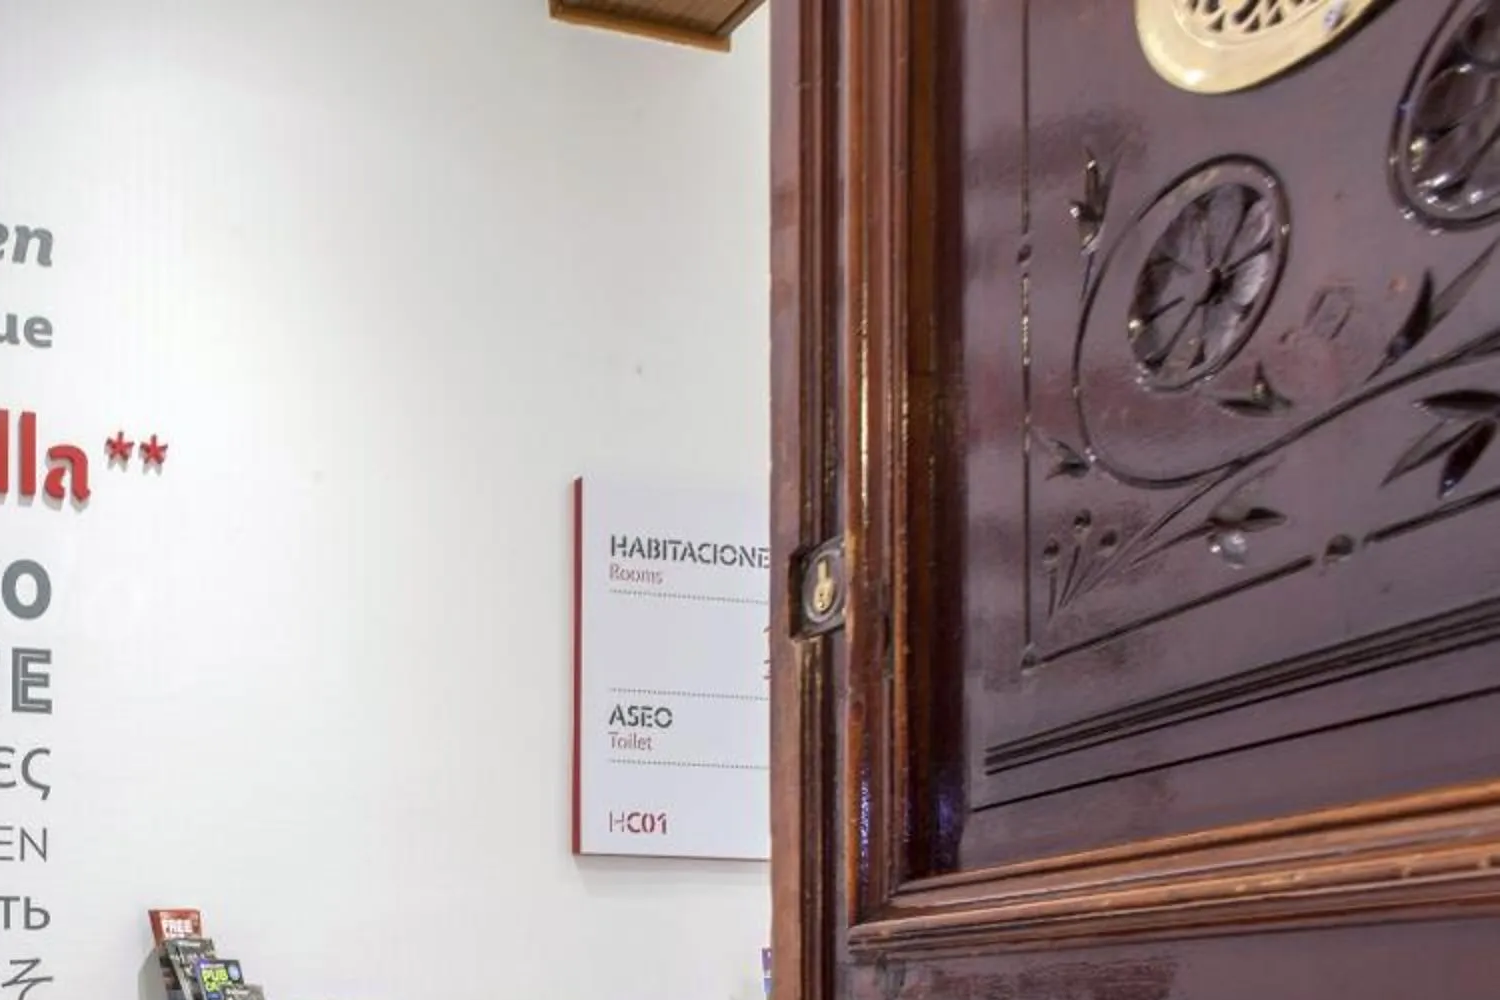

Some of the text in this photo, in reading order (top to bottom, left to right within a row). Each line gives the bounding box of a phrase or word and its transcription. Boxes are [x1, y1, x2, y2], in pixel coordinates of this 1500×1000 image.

[609, 564, 664, 585] Rooms
[608, 704, 674, 729] ASEO
[608, 731, 653, 752] Toilet
[609, 811, 668, 835] HC01
